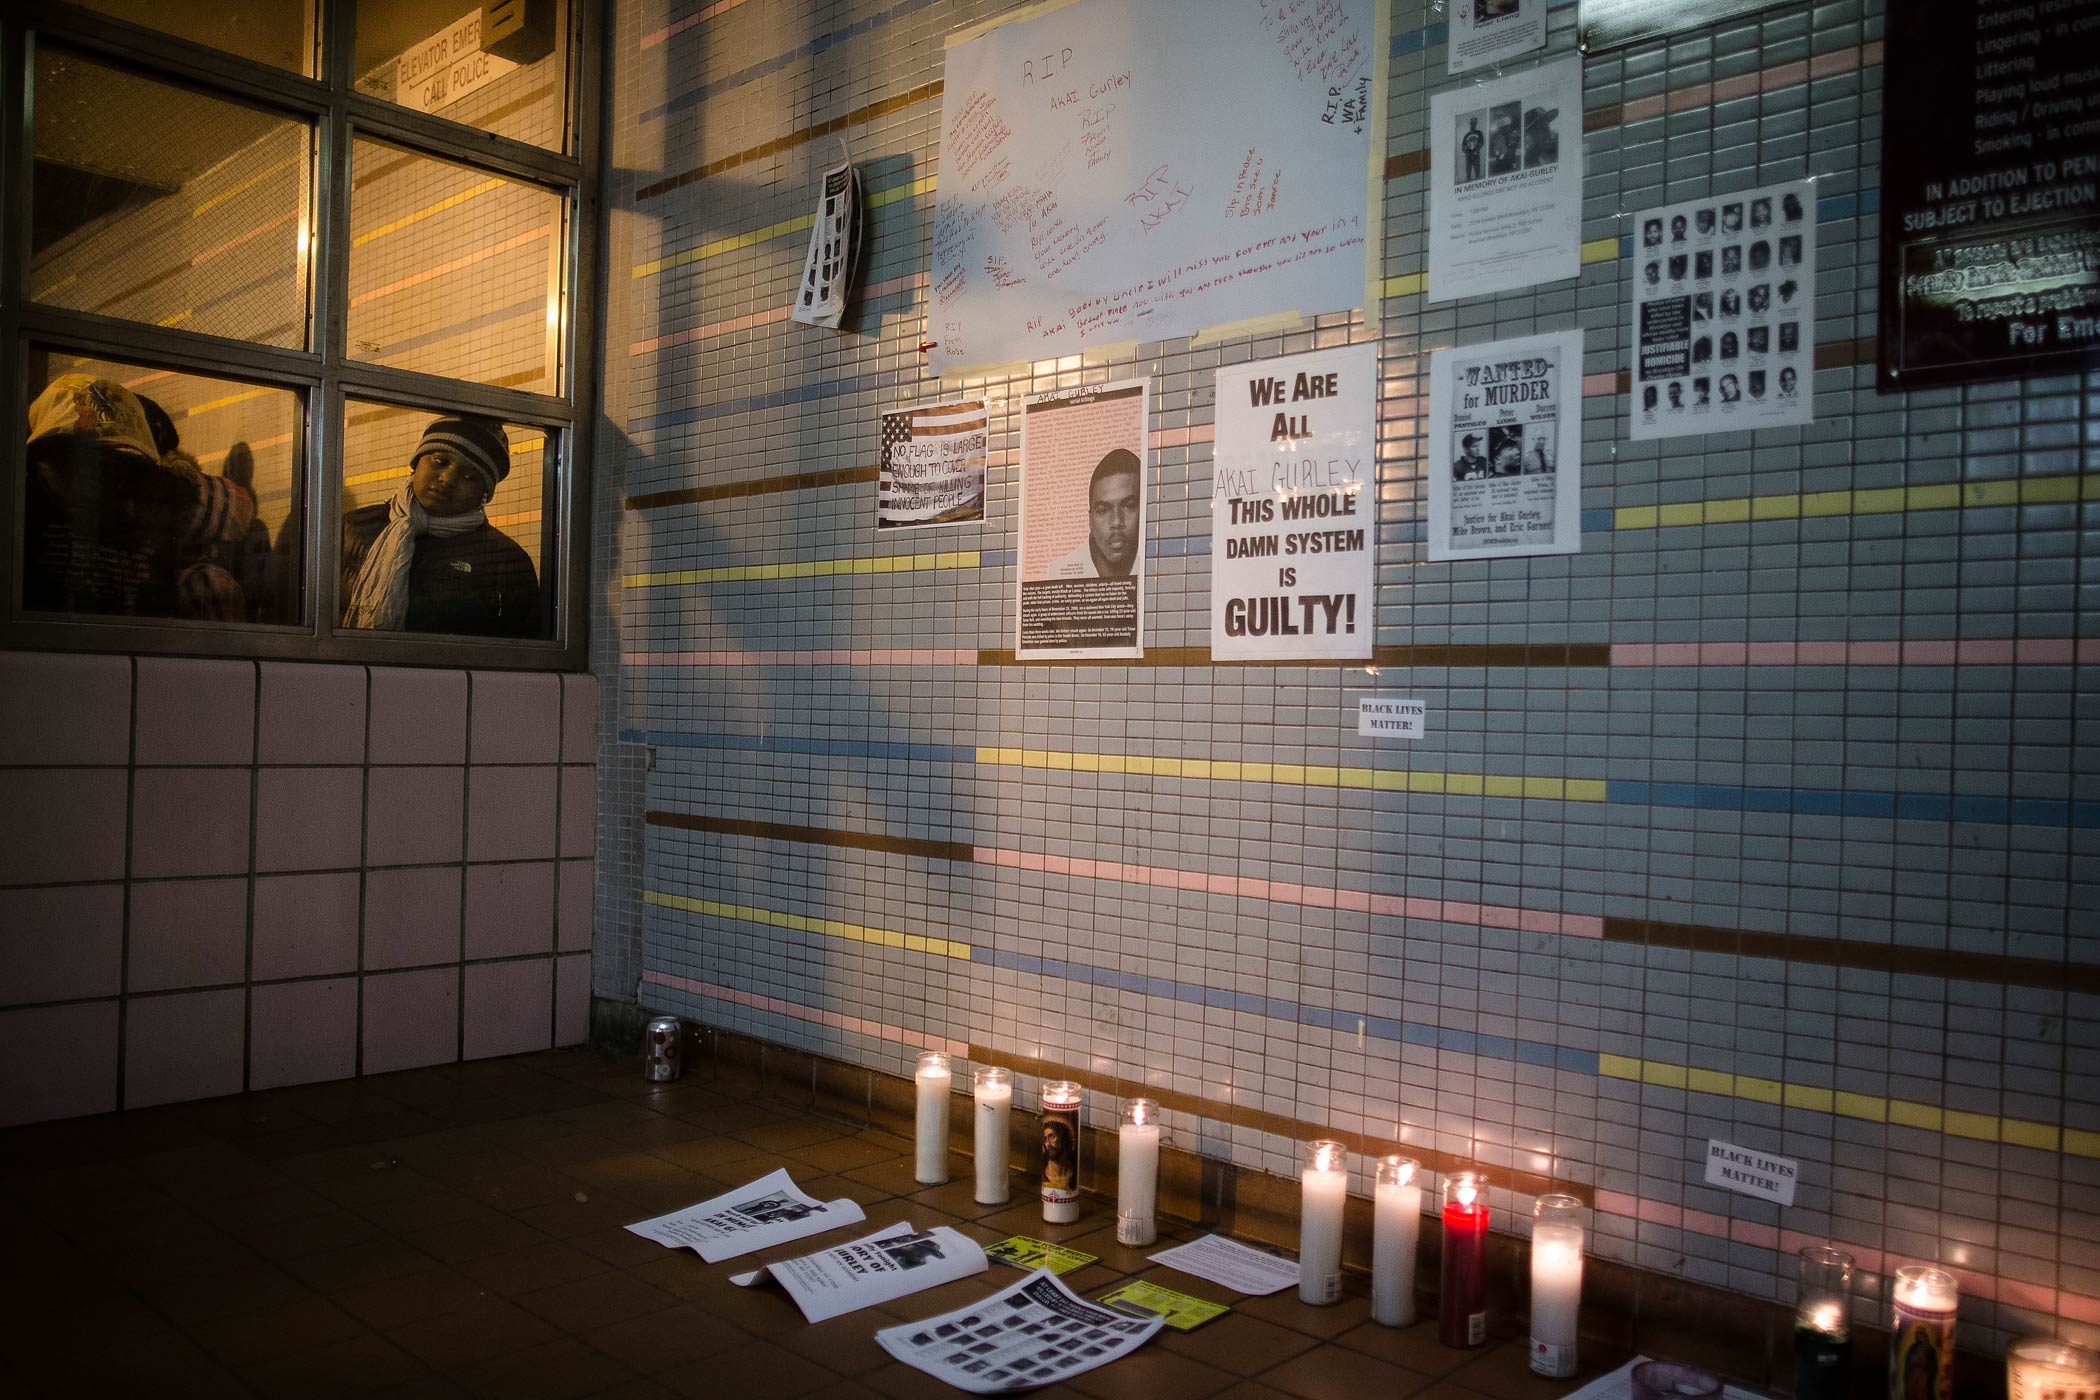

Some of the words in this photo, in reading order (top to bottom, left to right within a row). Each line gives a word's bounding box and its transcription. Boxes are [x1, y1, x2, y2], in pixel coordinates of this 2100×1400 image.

[401, 38, 448, 84] ELEVATOR
[424, 77, 447, 107] CALL
[453, 54, 489, 92] POLICE
[1050, 91, 1080, 112] AKAI
[1090, 71, 1131, 99] Gurley
[1454, 187, 1463, 195] IN
[1464, 178, 1497, 193] MEMORY
[1498, 176, 1509, 184] OF
[1510, 172, 1528, 182] AKAI
[1529, 165, 1558, 178] GURLEY
[1926, 183, 1942, 201] IN
[1948, 167, 2027, 197] ADDITION
[2034, 162, 2057, 183] TO
[1904, 204, 1977, 232] SUBJECT
[1983, 199, 2005, 220] TO
[2010, 182, 2096, 214] EJECTION
[2008, 320, 2048, 346] For
[1641, 340, 1689, 355] JUSTIFIABLE
[1644, 353, 1685, 368] HOMICIDE
[1466, 357, 1549, 387] WANTED
[1463, 393, 1479, 409] for
[1485, 380, 1550, 407] MURDER
[893, 446, 906, 458] NO
[908, 444, 934, 459] FLAG
[940, 442, 950, 457] IS
[953, 434, 983, 455] LARGE
[891, 463, 927, 479] ENOUGH
[929, 462, 941, 476] TO
[942, 459, 967, 476] COVER
[1215, 467, 1260, 498] AKAI
[1271, 459, 1361, 494] GURLEY
[934, 492, 962, 509] PEOPLE
[1281, 493, 1357, 521] WHOLE
[1226, 535, 1279, 560] DAMN
[1285, 529, 1365, 556] SYSTEM
[1279, 567, 1297, 588] IS
[1224, 593, 1356, 638] GUILTY!
[1362, 703, 1393, 714] BLACK
[1395, 705, 1424, 716] LIVES
[1370, 719, 1413, 731] MATTER!
[1711, 1146, 1753, 1167] BLACK
[1756, 1158, 1794, 1179] LIVES
[1721, 1166, 1779, 1192] MATTER!
[870, 1262, 887, 1273] OF
